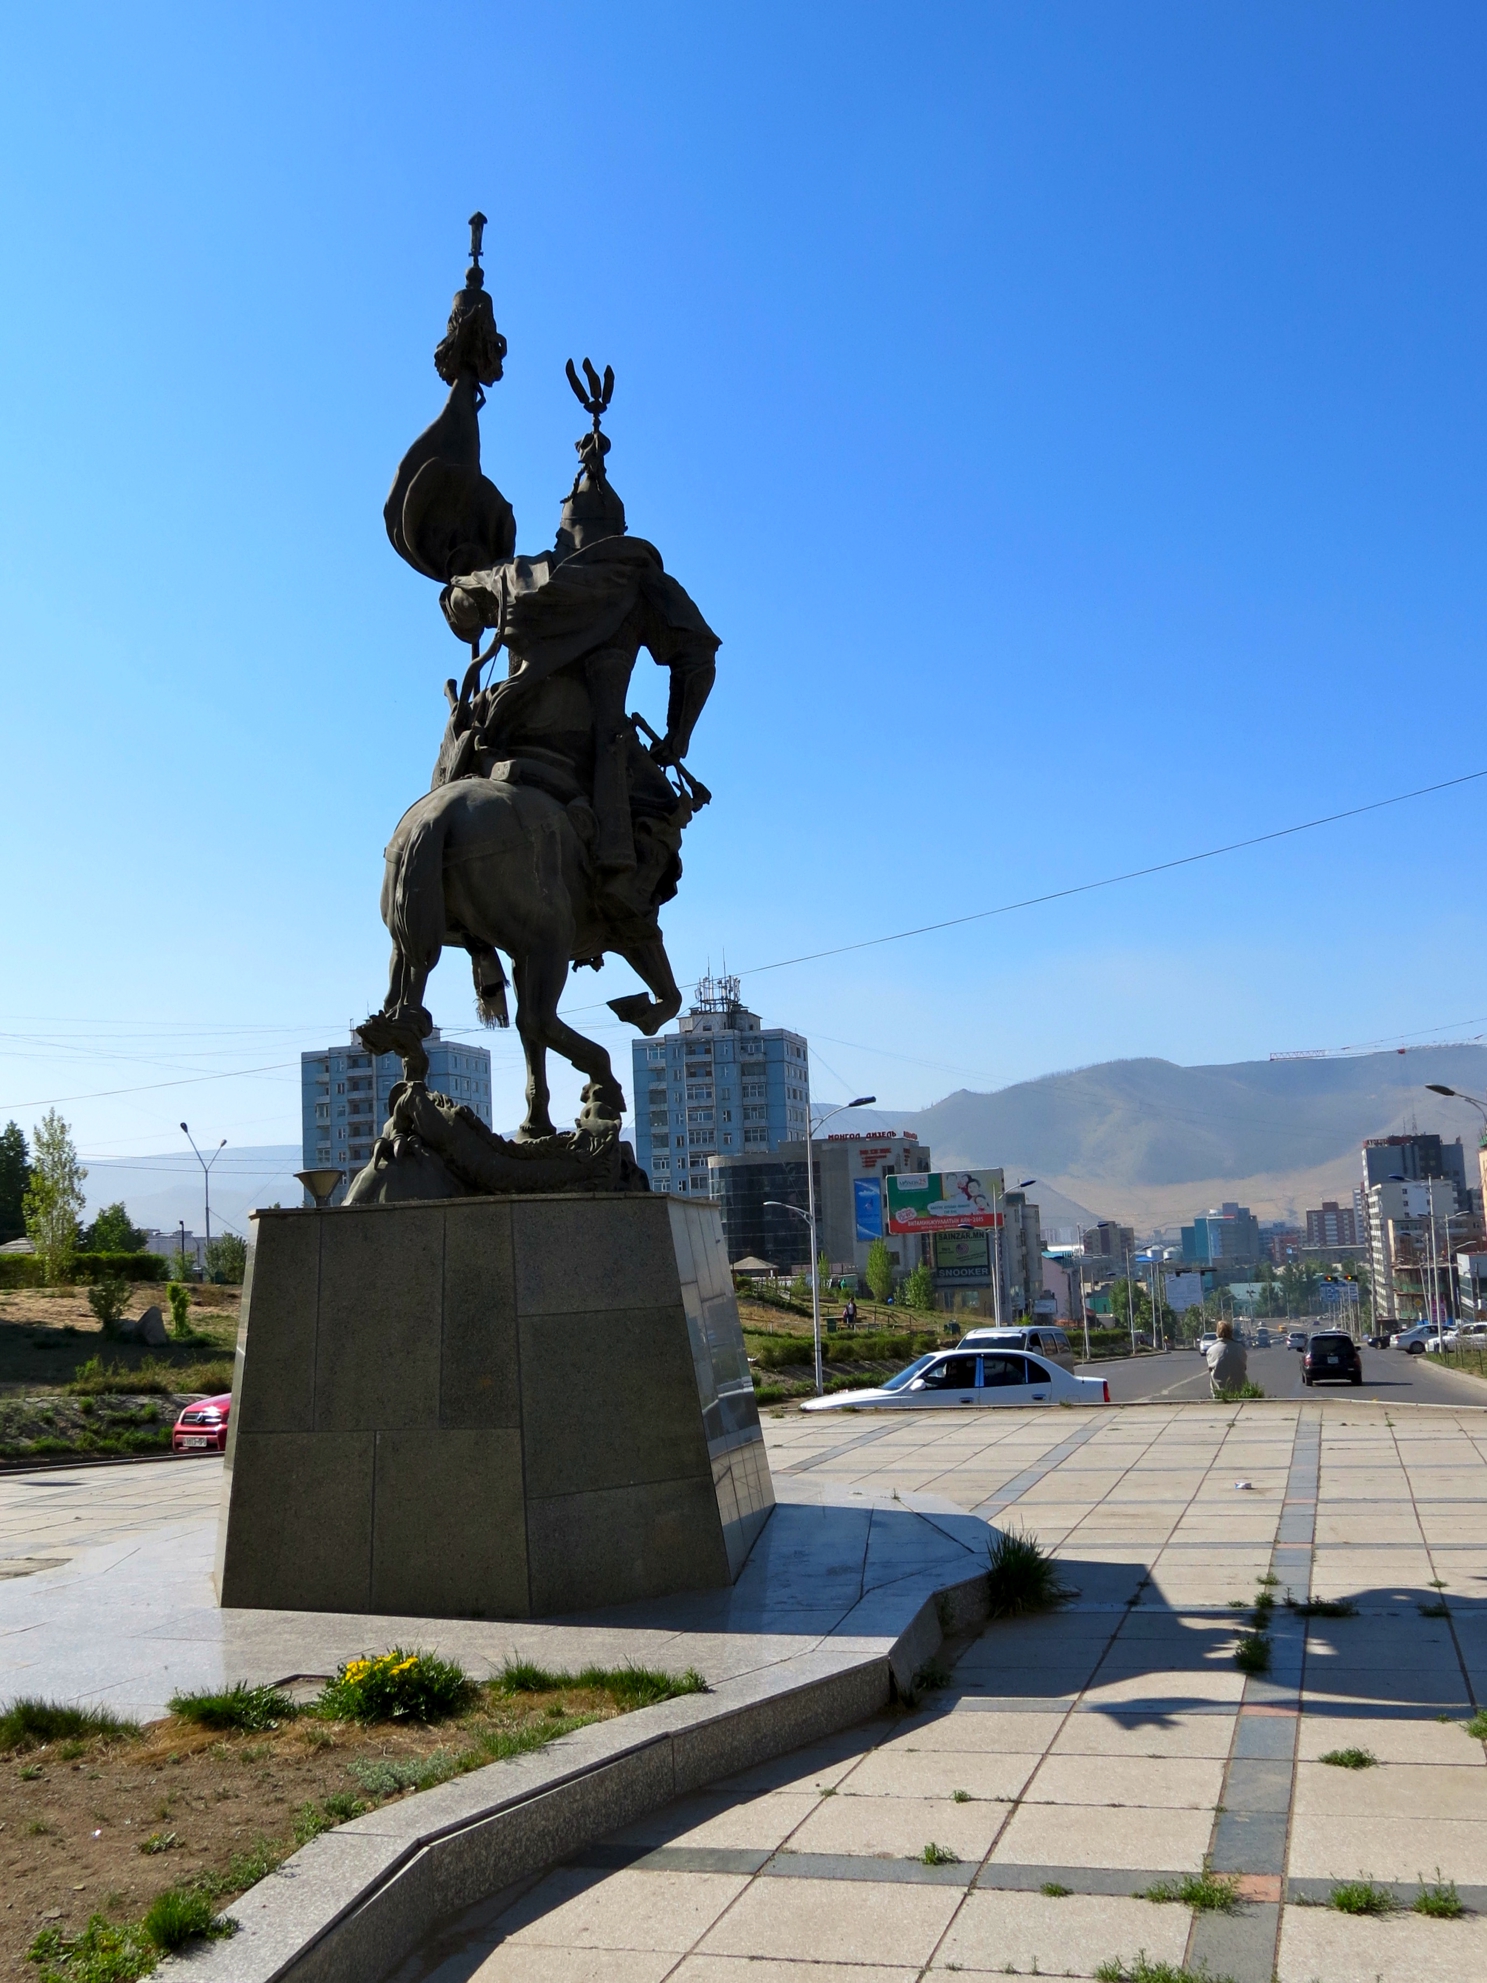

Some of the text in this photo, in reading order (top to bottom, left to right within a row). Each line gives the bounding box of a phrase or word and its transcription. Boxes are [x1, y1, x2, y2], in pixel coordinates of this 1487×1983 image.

[828, 1133, 860, 1141] МОНГОЛ
[865, 1130, 897, 1140] ДИЗЕЛЬ
[938, 1231, 985, 1240] SAINZAR.MN
[938, 1267, 989, 1277] SNOOKER
